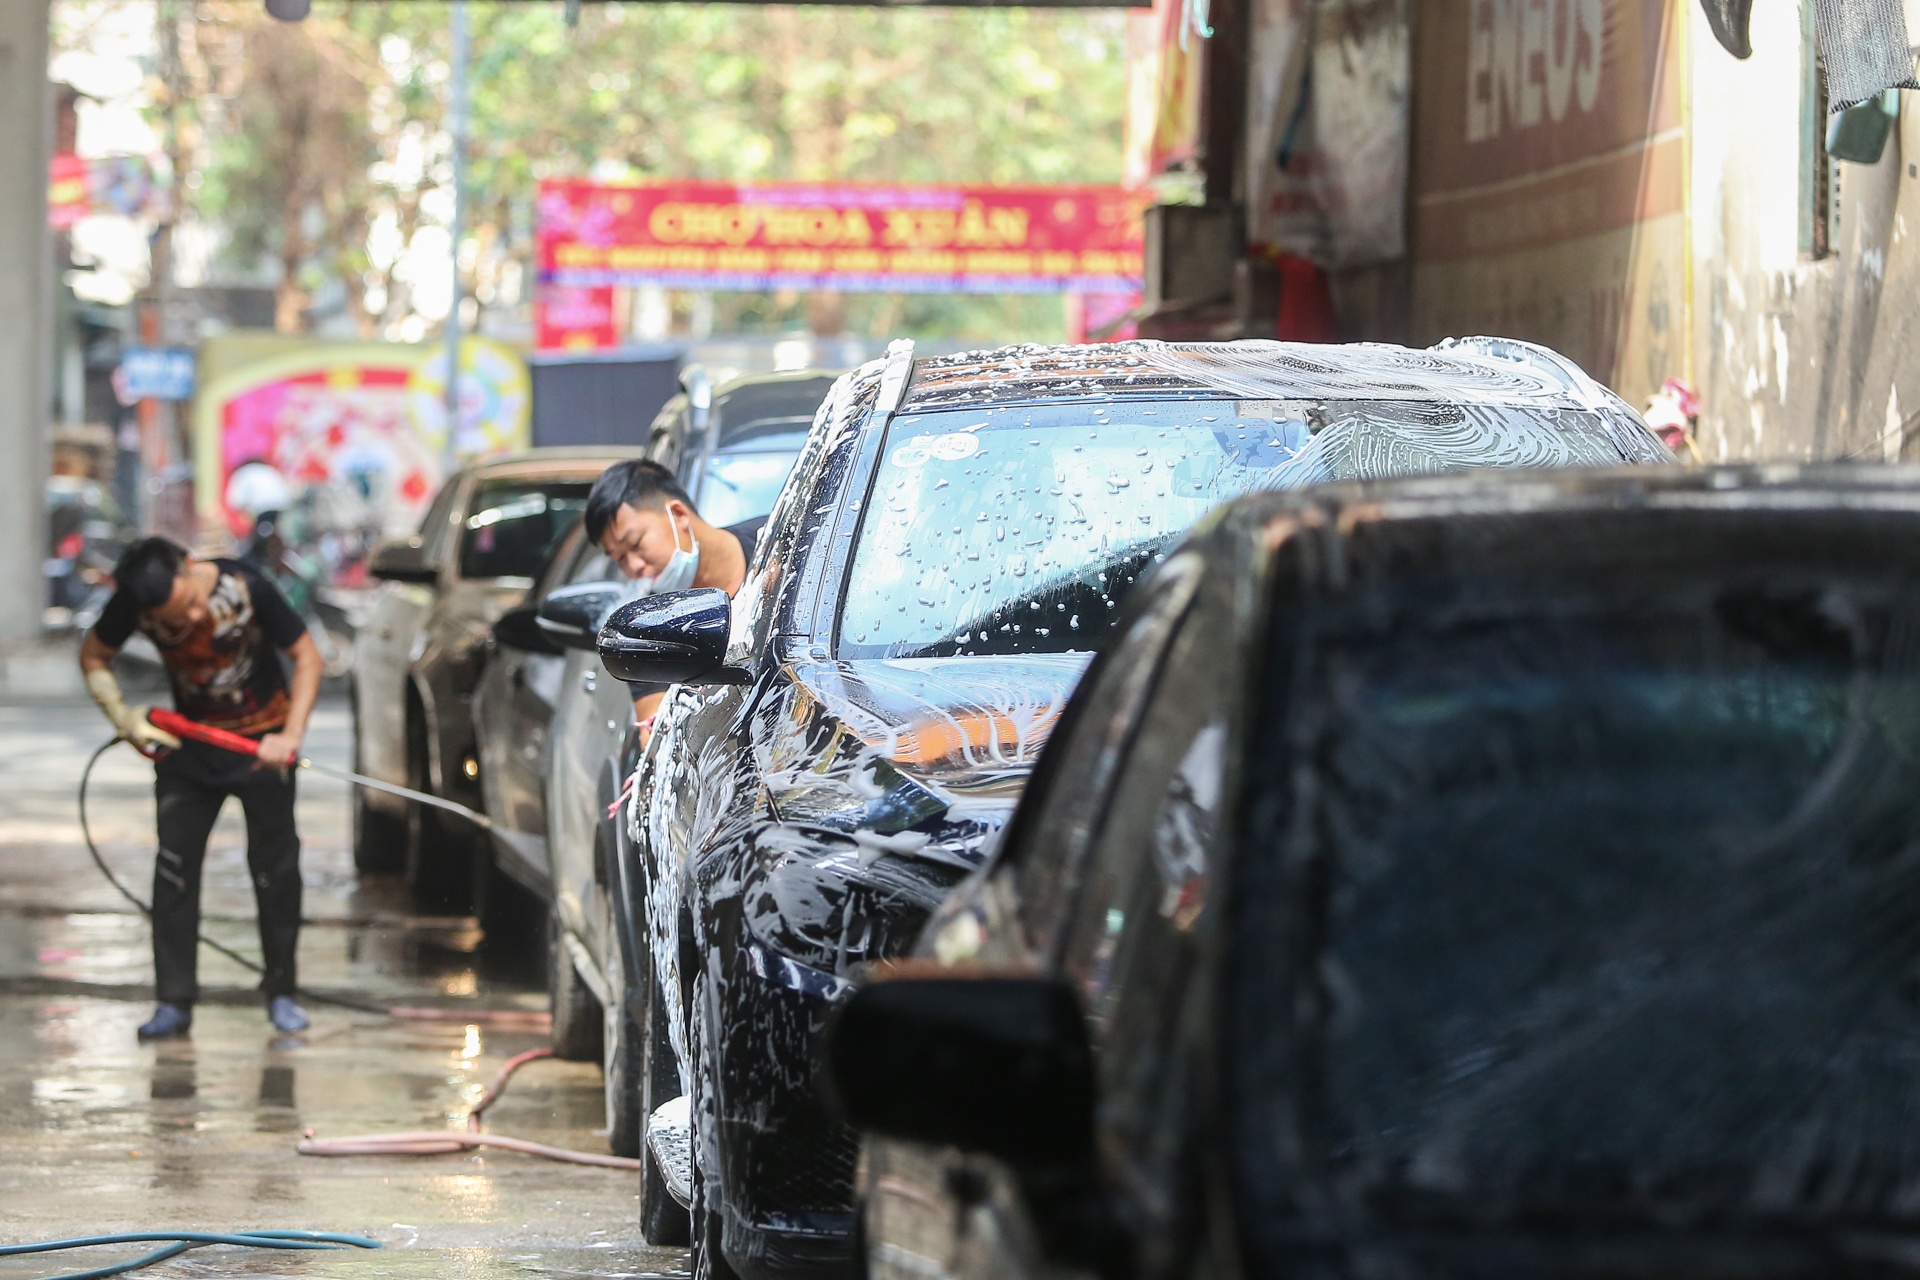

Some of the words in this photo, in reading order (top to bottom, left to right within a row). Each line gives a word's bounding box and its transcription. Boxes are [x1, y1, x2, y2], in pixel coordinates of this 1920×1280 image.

[1465, 0, 1603, 143] ENEOS
[764, 206, 873, 247] HOA
[882, 197, 1030, 249] XUÂN
